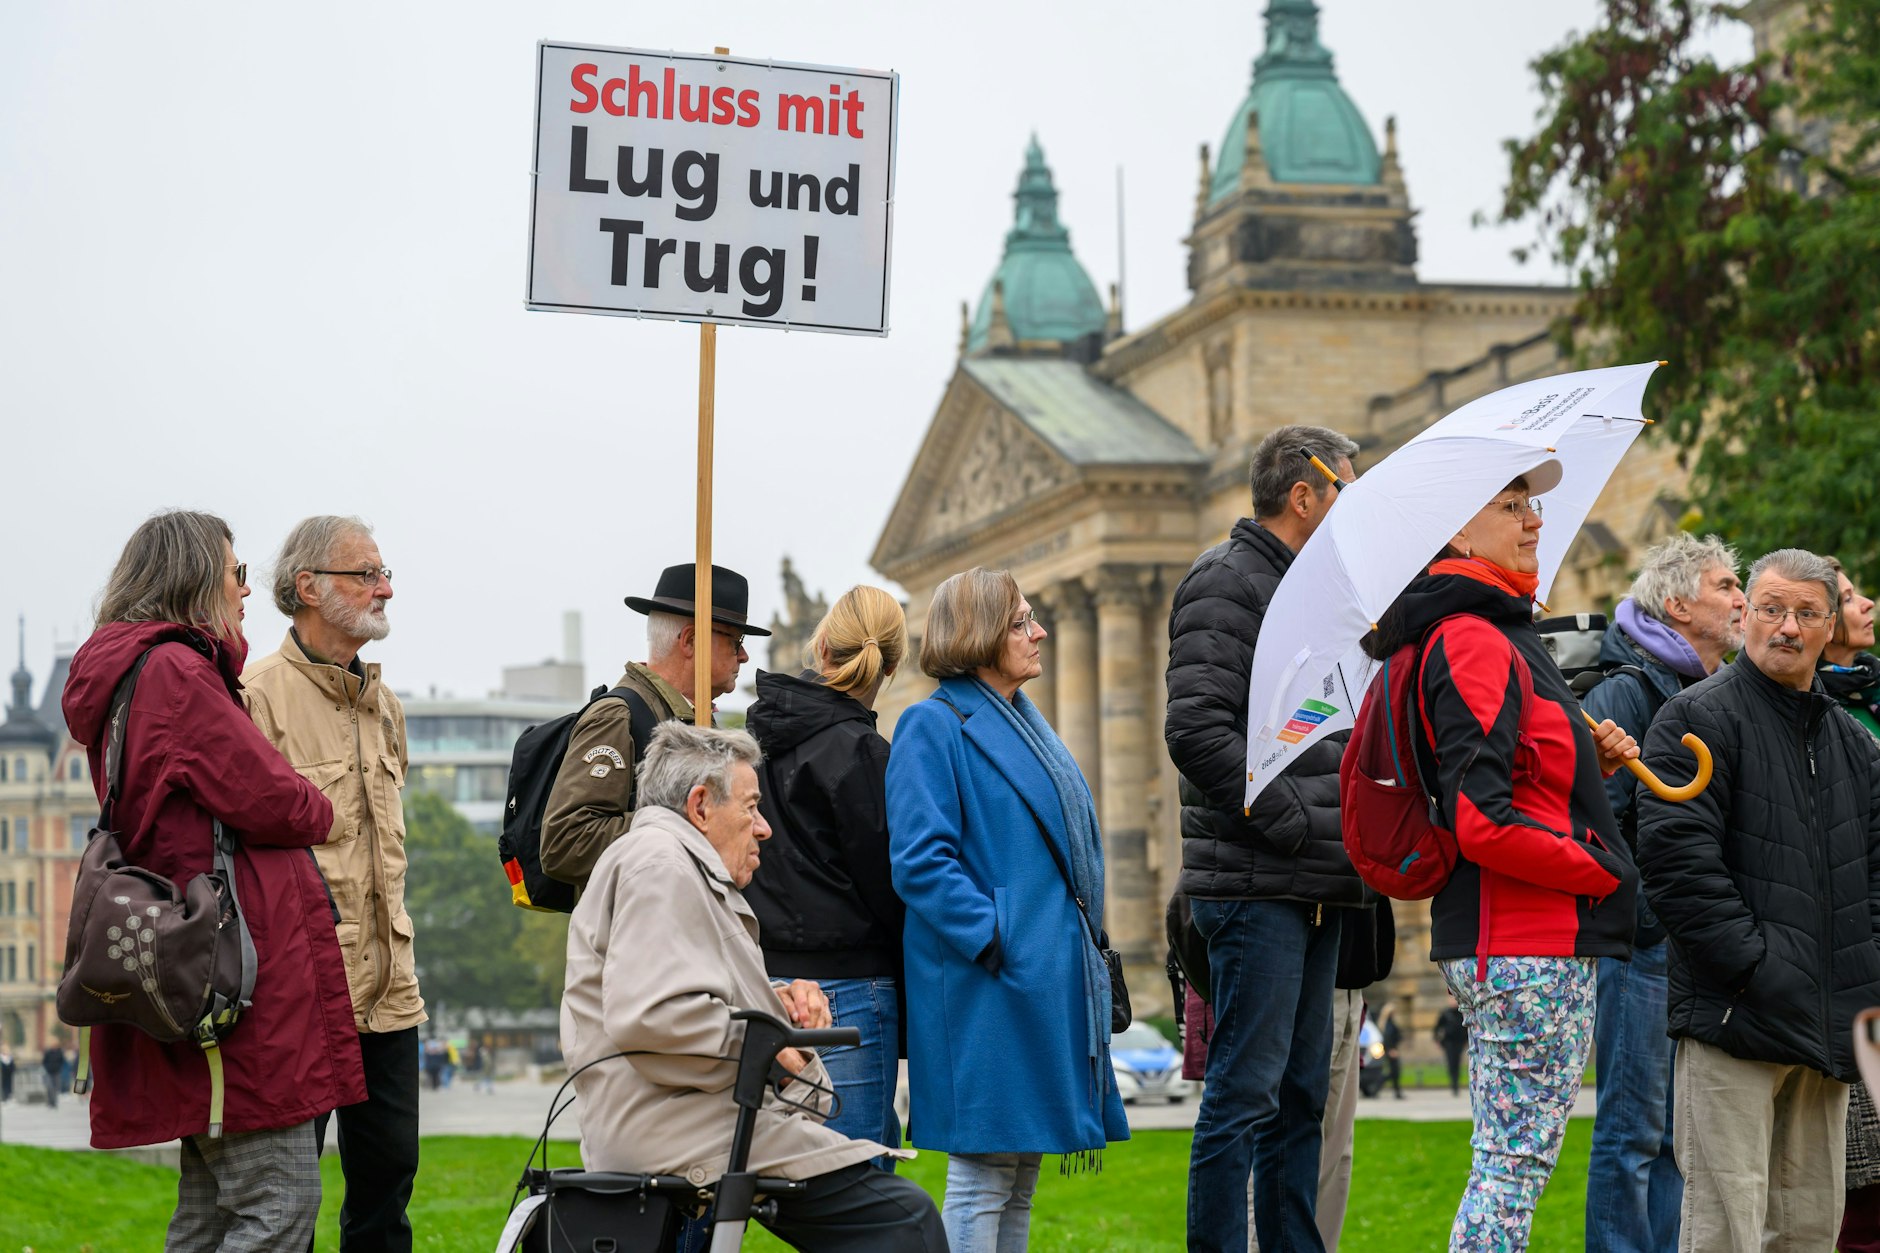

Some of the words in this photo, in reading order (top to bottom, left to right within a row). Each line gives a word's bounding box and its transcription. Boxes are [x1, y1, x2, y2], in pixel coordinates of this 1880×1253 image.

[569, 62, 761, 128] Schluss
[777, 84, 865, 139] mit
[569, 125, 720, 221] Lug
[748, 163, 861, 216] und
[599, 217, 820, 318] Trug!
[587, 747, 622, 766] PROTEST
